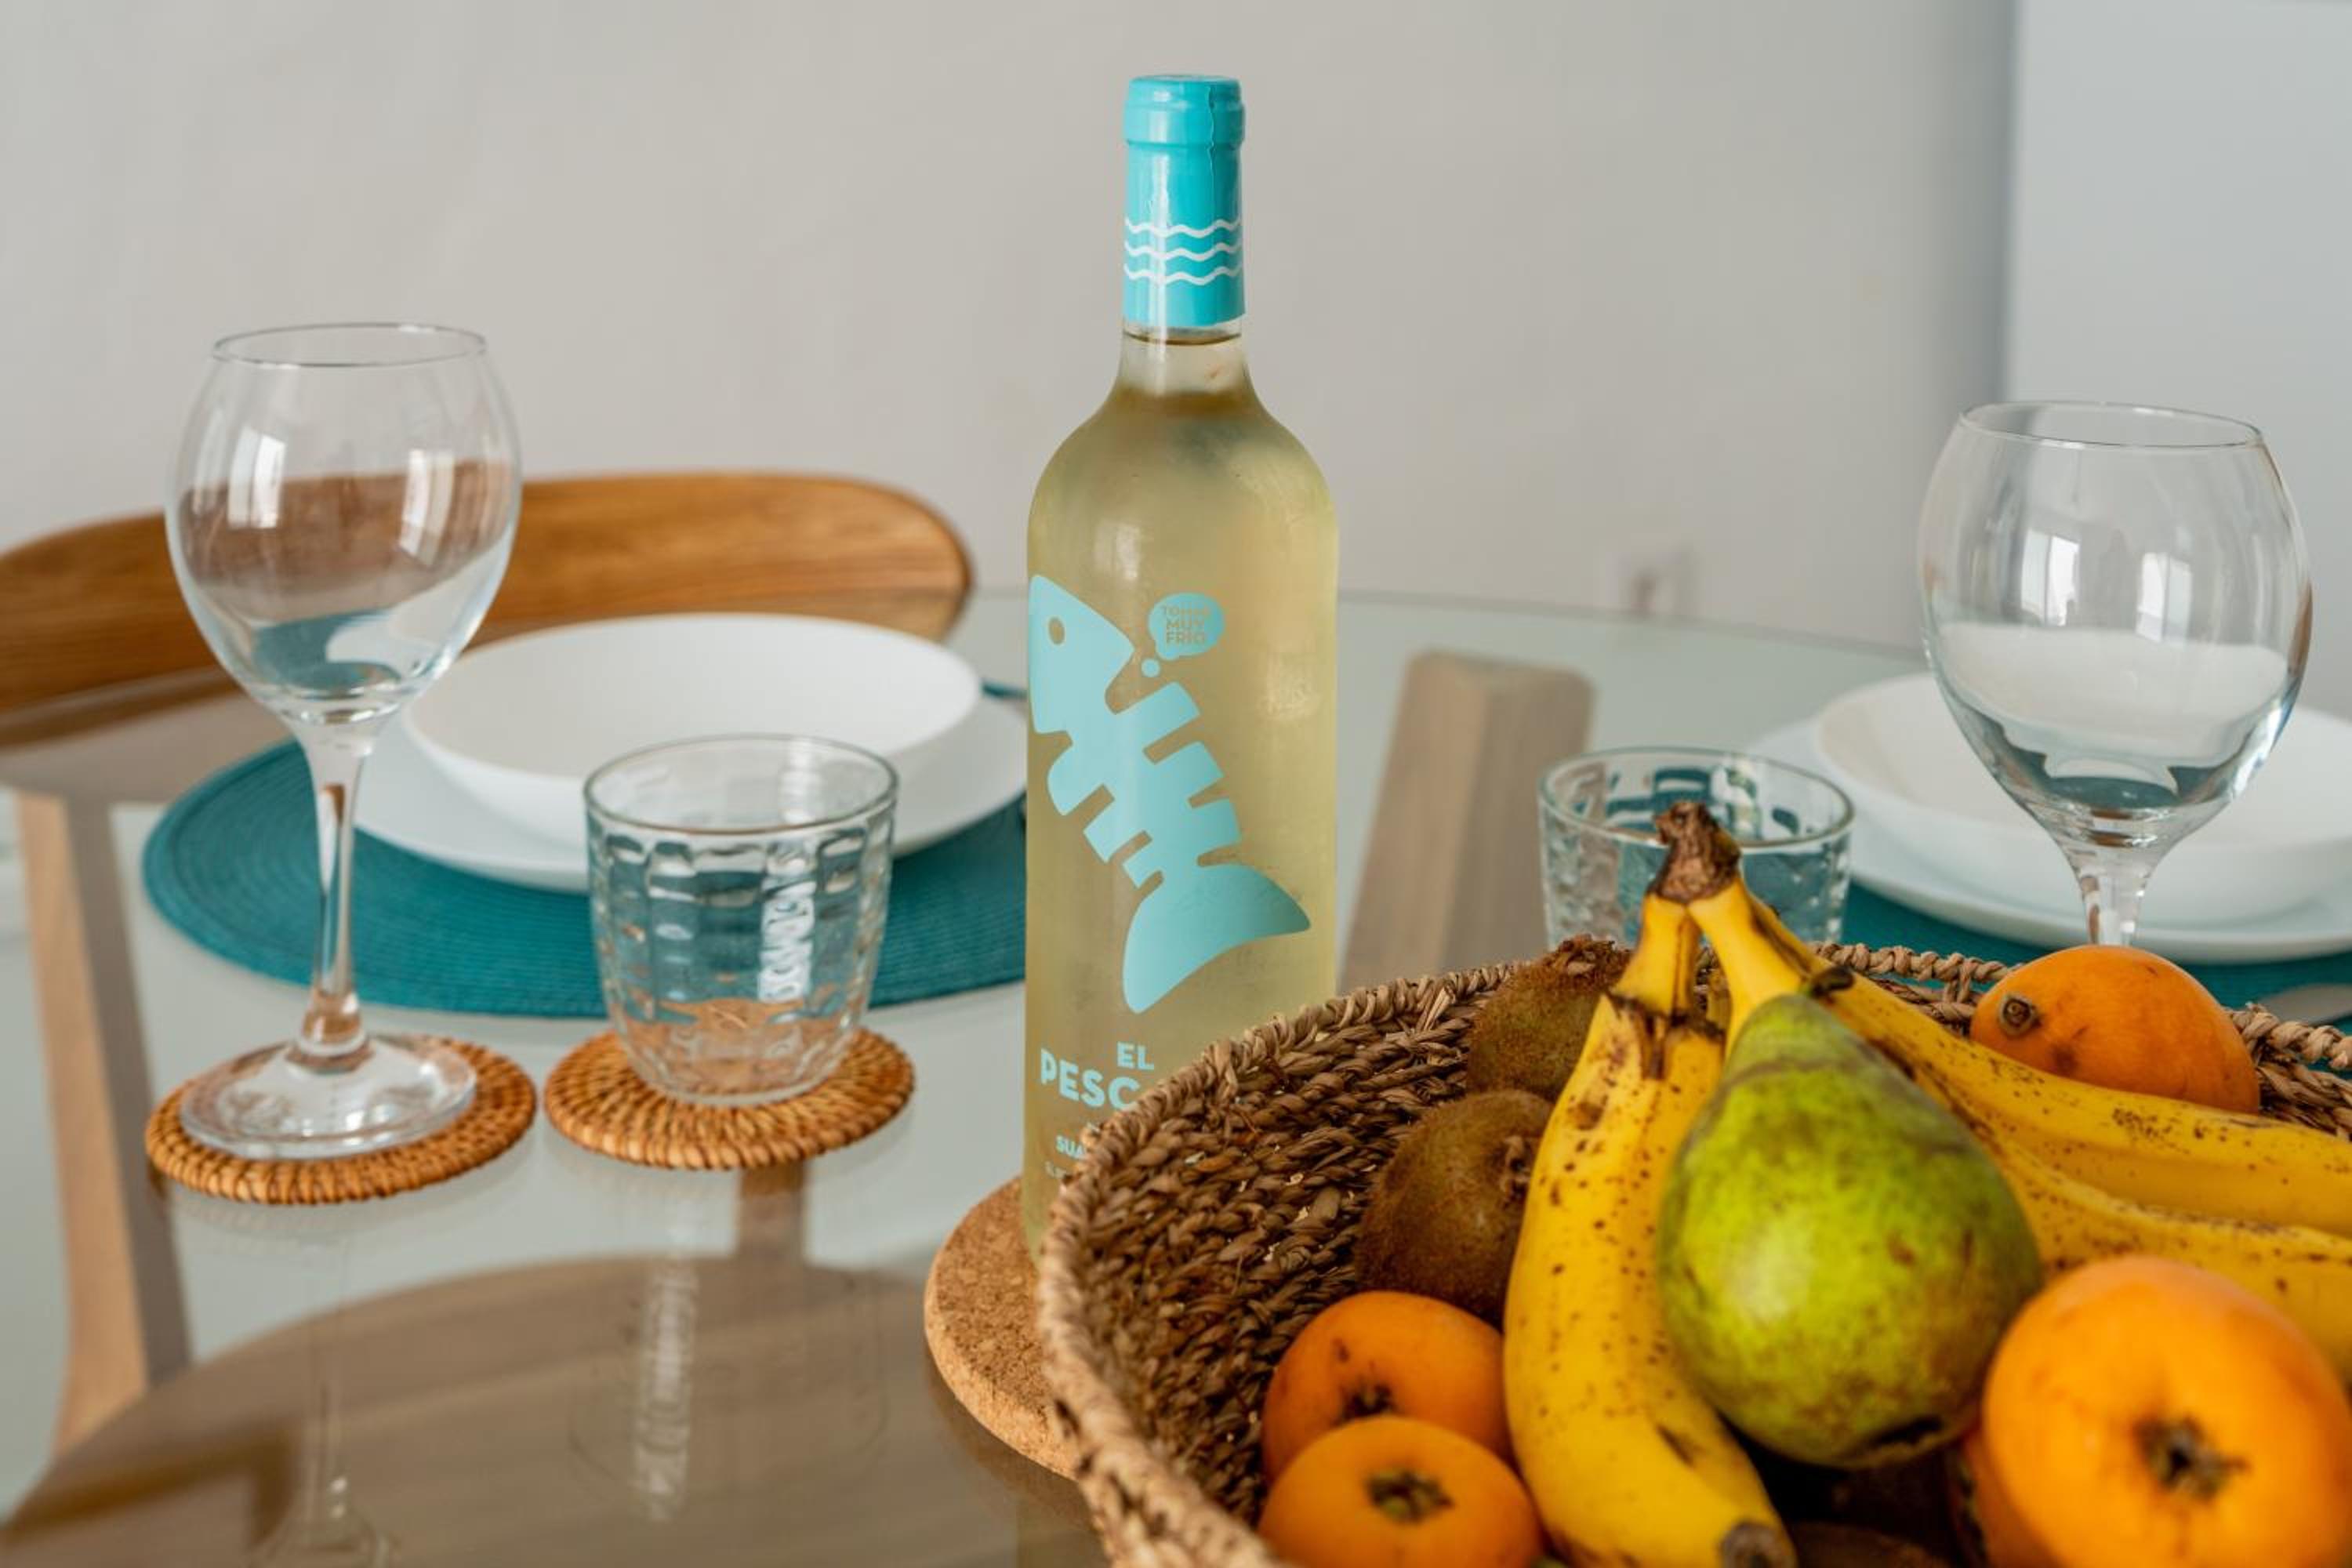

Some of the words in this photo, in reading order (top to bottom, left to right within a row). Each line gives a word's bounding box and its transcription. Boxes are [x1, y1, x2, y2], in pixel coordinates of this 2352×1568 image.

[1116, 1040, 1154, 1070] EL
[1040, 1047, 1141, 1111] PESC
[1055, 1134, 1086, 1160] SUA
